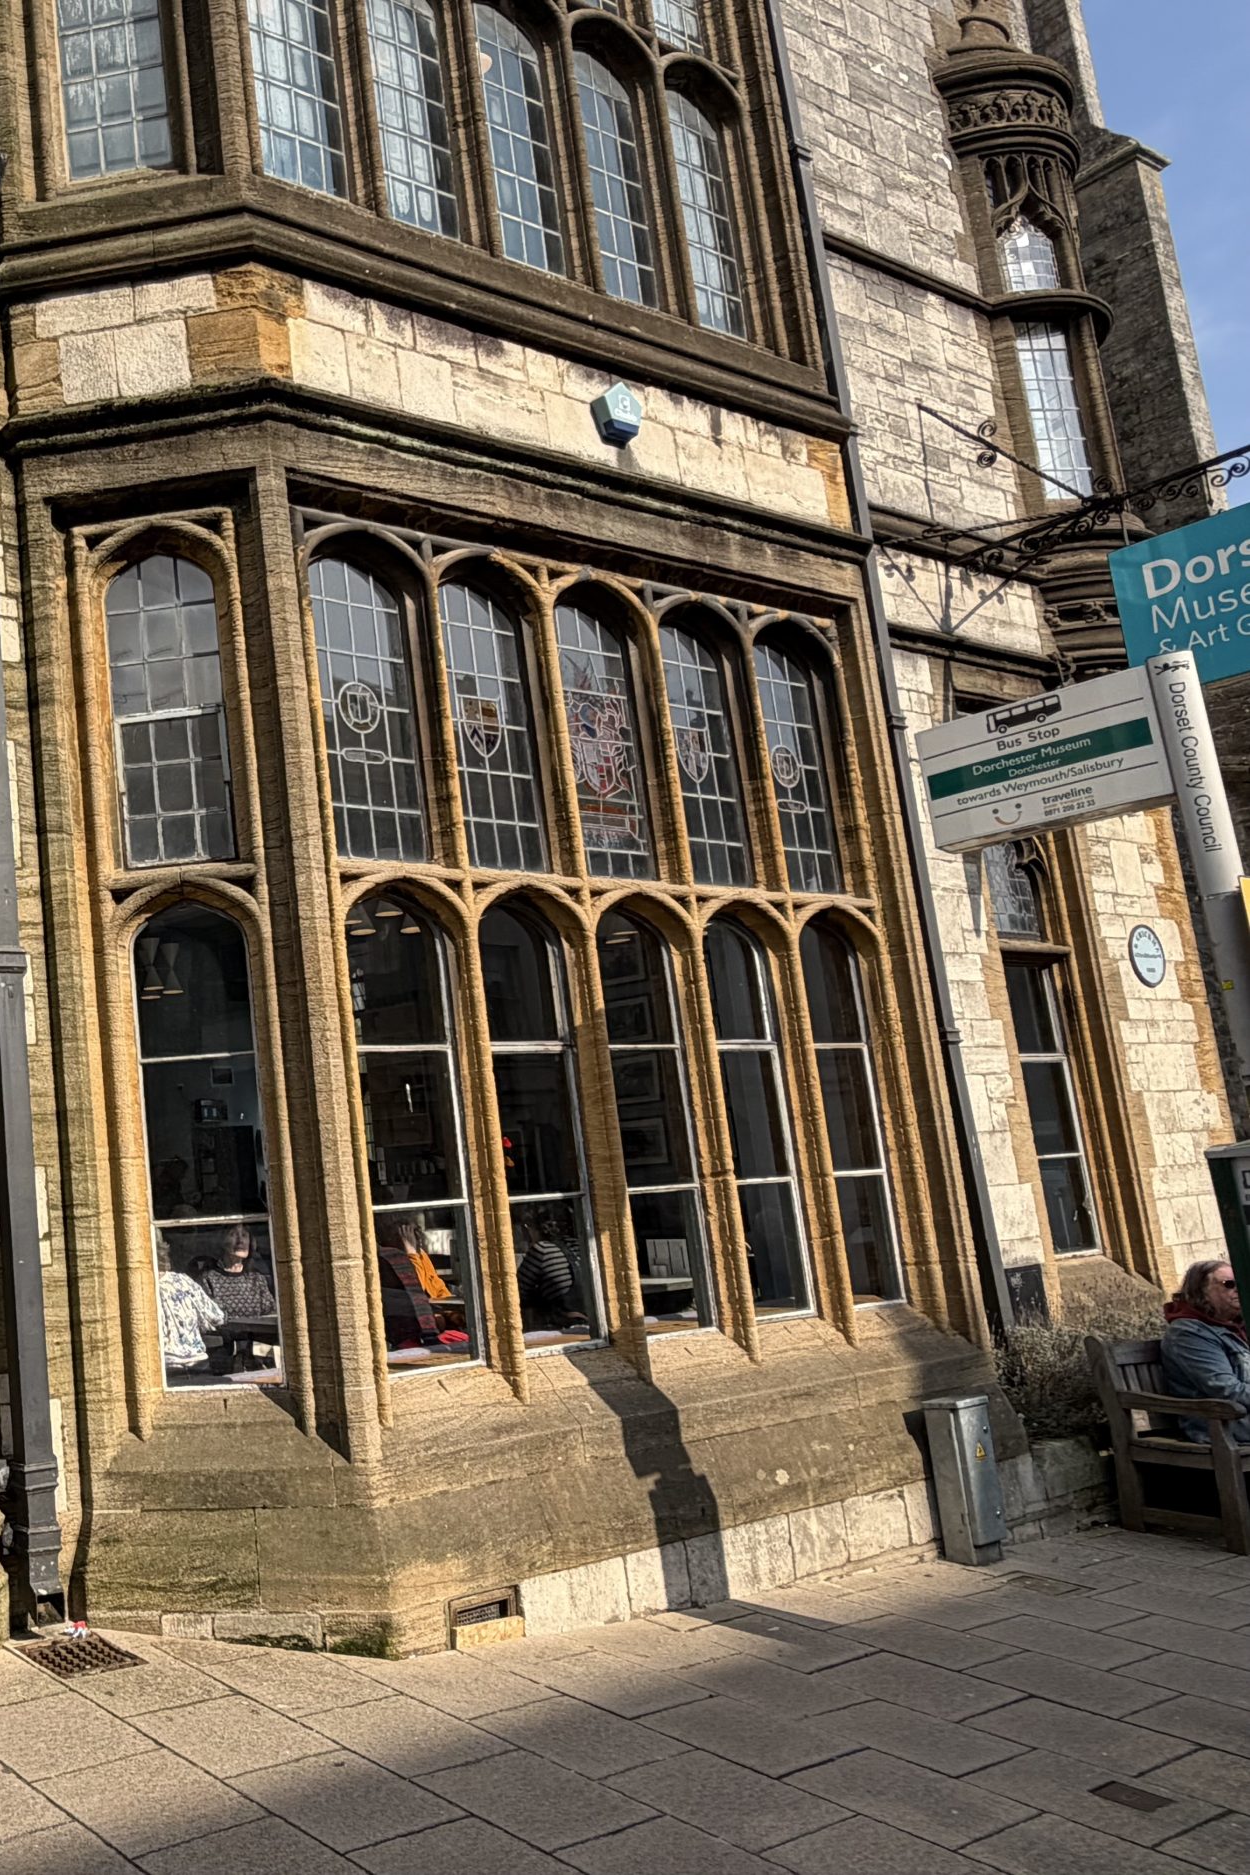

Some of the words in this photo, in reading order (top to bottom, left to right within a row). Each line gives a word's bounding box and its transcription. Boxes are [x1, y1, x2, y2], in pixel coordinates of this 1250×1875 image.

[1187, 623, 1230, 651] Art
[1169, 681, 1194, 733] Dorset
[972, 752, 1038, 776] Dorchester
[1040, 737, 1091, 758] Museum
[997, 738, 1022, 751] Bus
[1028, 727, 1060, 743] Stop
[957, 789, 1001, 806] towards
[1002, 757, 1124, 793] Weymouth/Salisbury
[1008, 758, 1061, 778] Dorchester
[1181, 735, 1206, 789] County
[1041, 786, 1093, 804] traveline
[1194, 794, 1222, 853] Council
